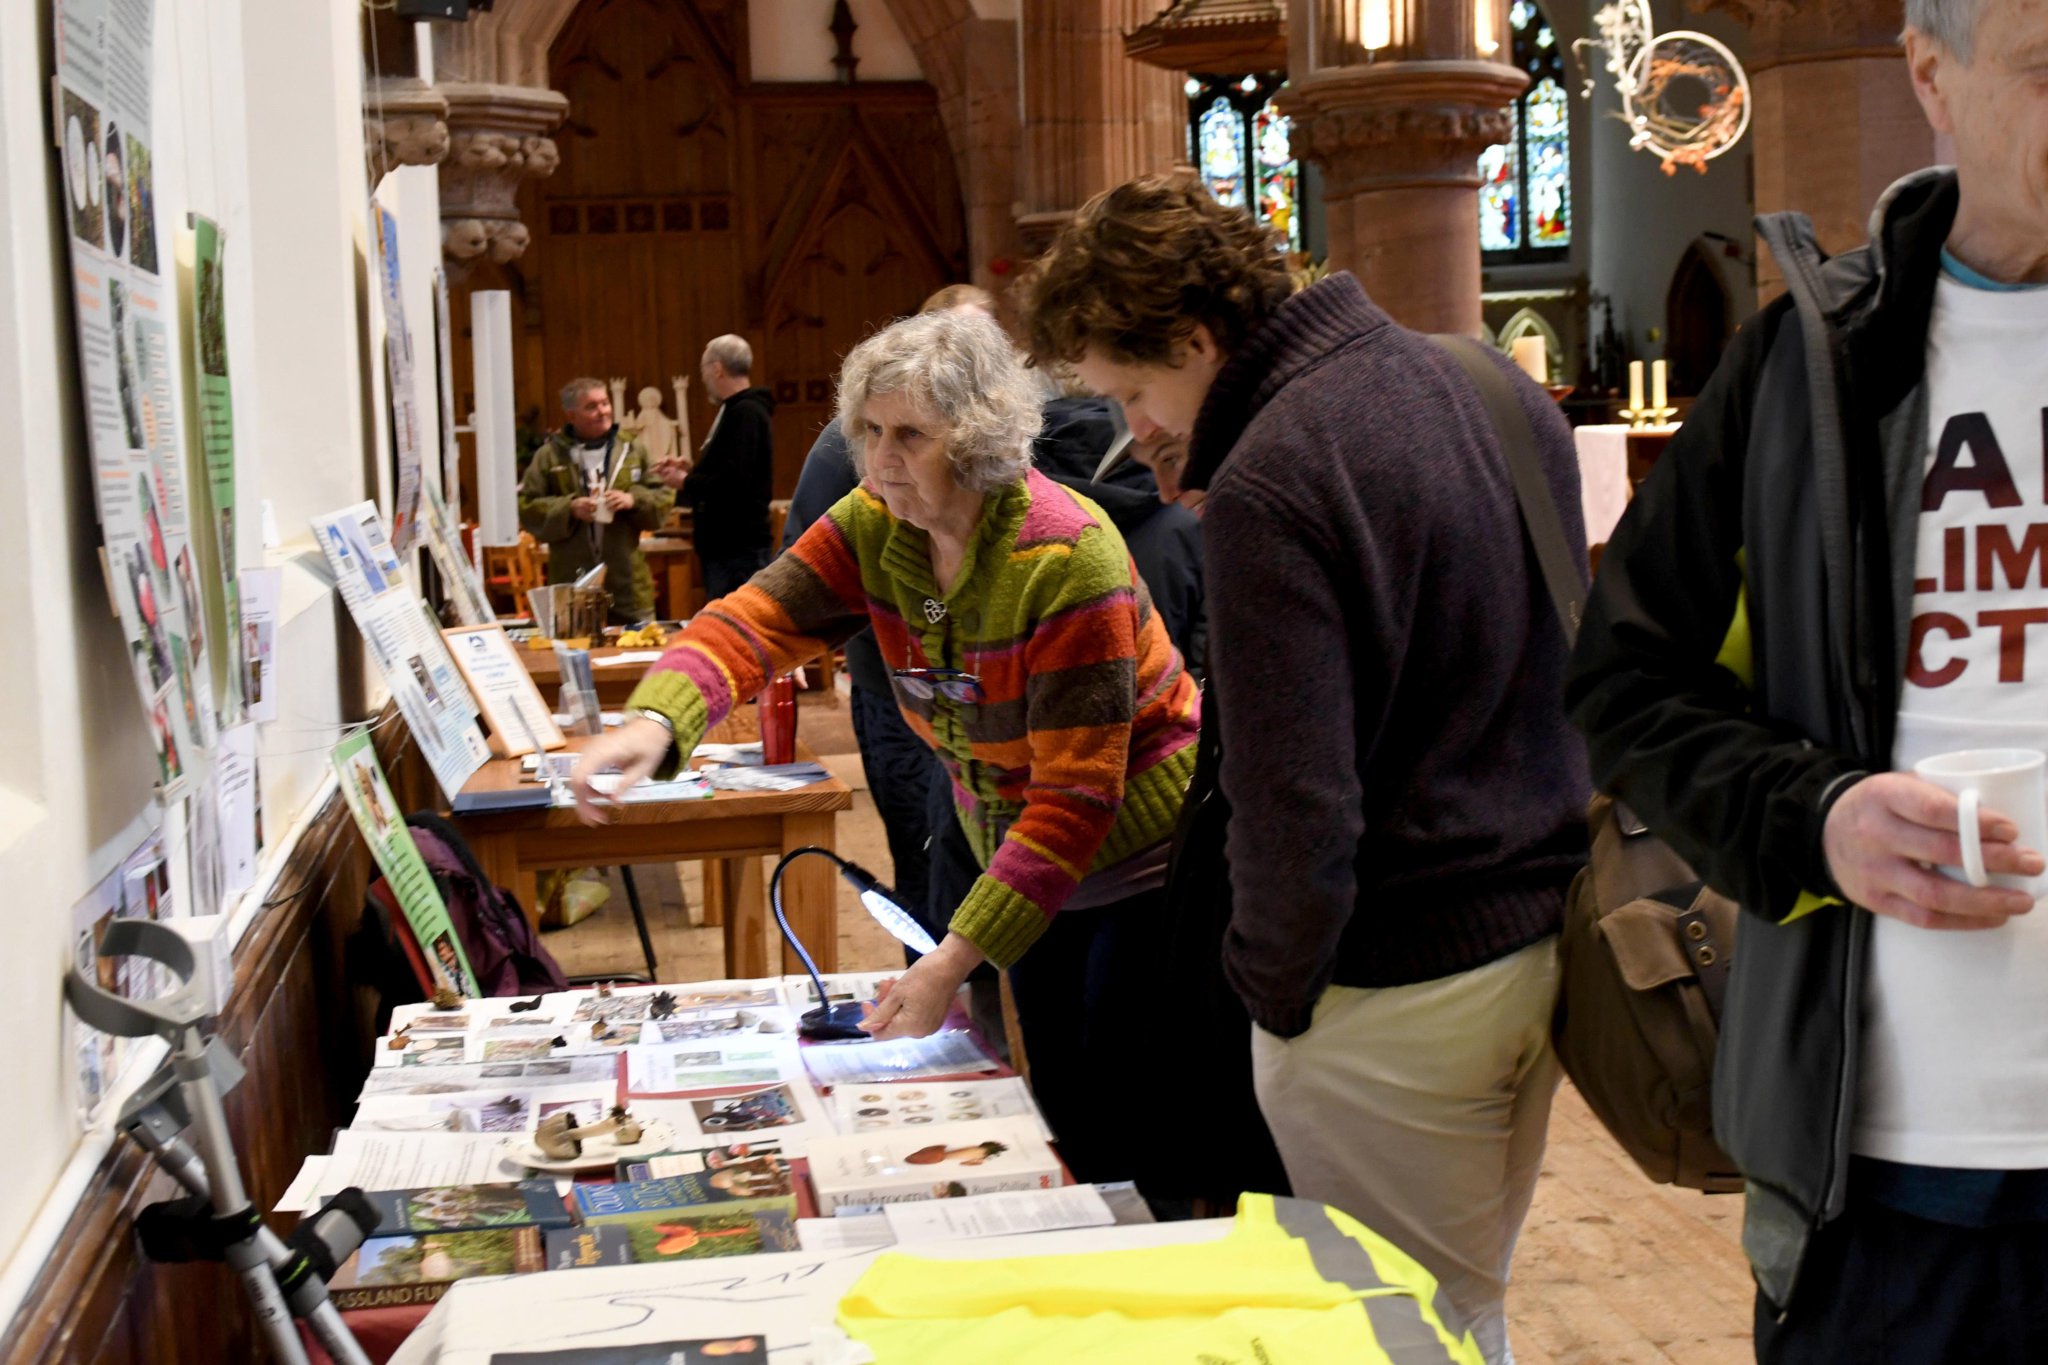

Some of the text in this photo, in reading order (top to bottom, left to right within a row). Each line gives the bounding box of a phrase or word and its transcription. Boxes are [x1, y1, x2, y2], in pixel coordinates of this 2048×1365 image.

[1920, 406, 2048, 511] A
[1905, 608, 2048, 688] CT
[331, 1287, 412, 1308] ASSLAND
